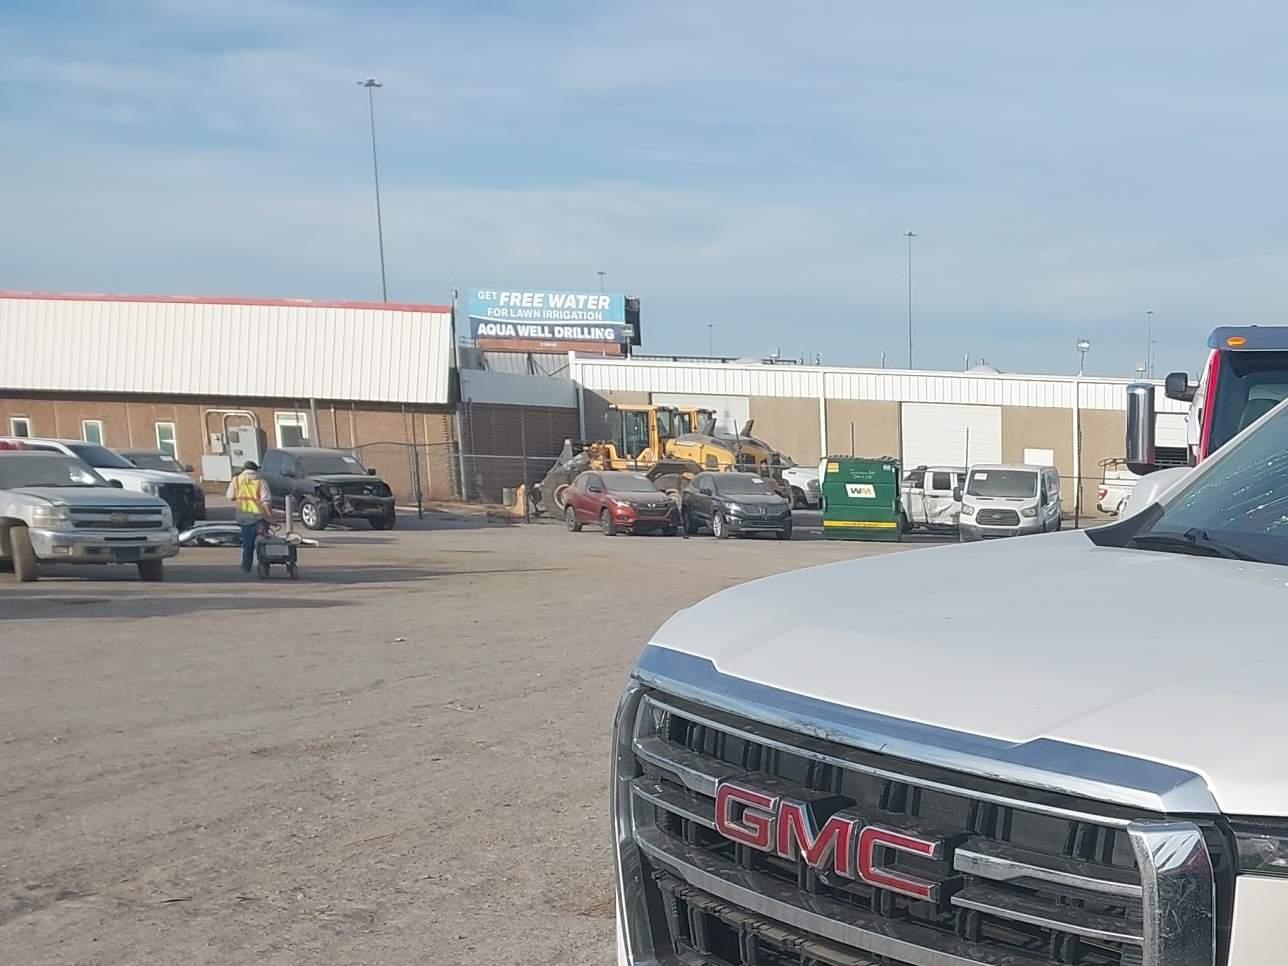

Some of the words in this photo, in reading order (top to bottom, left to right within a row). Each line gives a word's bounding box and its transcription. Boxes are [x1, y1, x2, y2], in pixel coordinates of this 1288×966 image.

[478, 291, 497, 300] GET
[499, 292, 545, 308] FREE
[548, 293, 611, 309] WATER
[487, 308, 509, 317] FOR
[510, 309, 542, 319] LAWN
[542, 310, 603, 321] IRRIGATION
[477, 323, 516, 337] AQUA
[518, 324, 553, 338] WELL
[554, 325, 615, 340] DRILLING
[850, 487, 872, 495] WM
[715, 782, 944, 904] GMC
